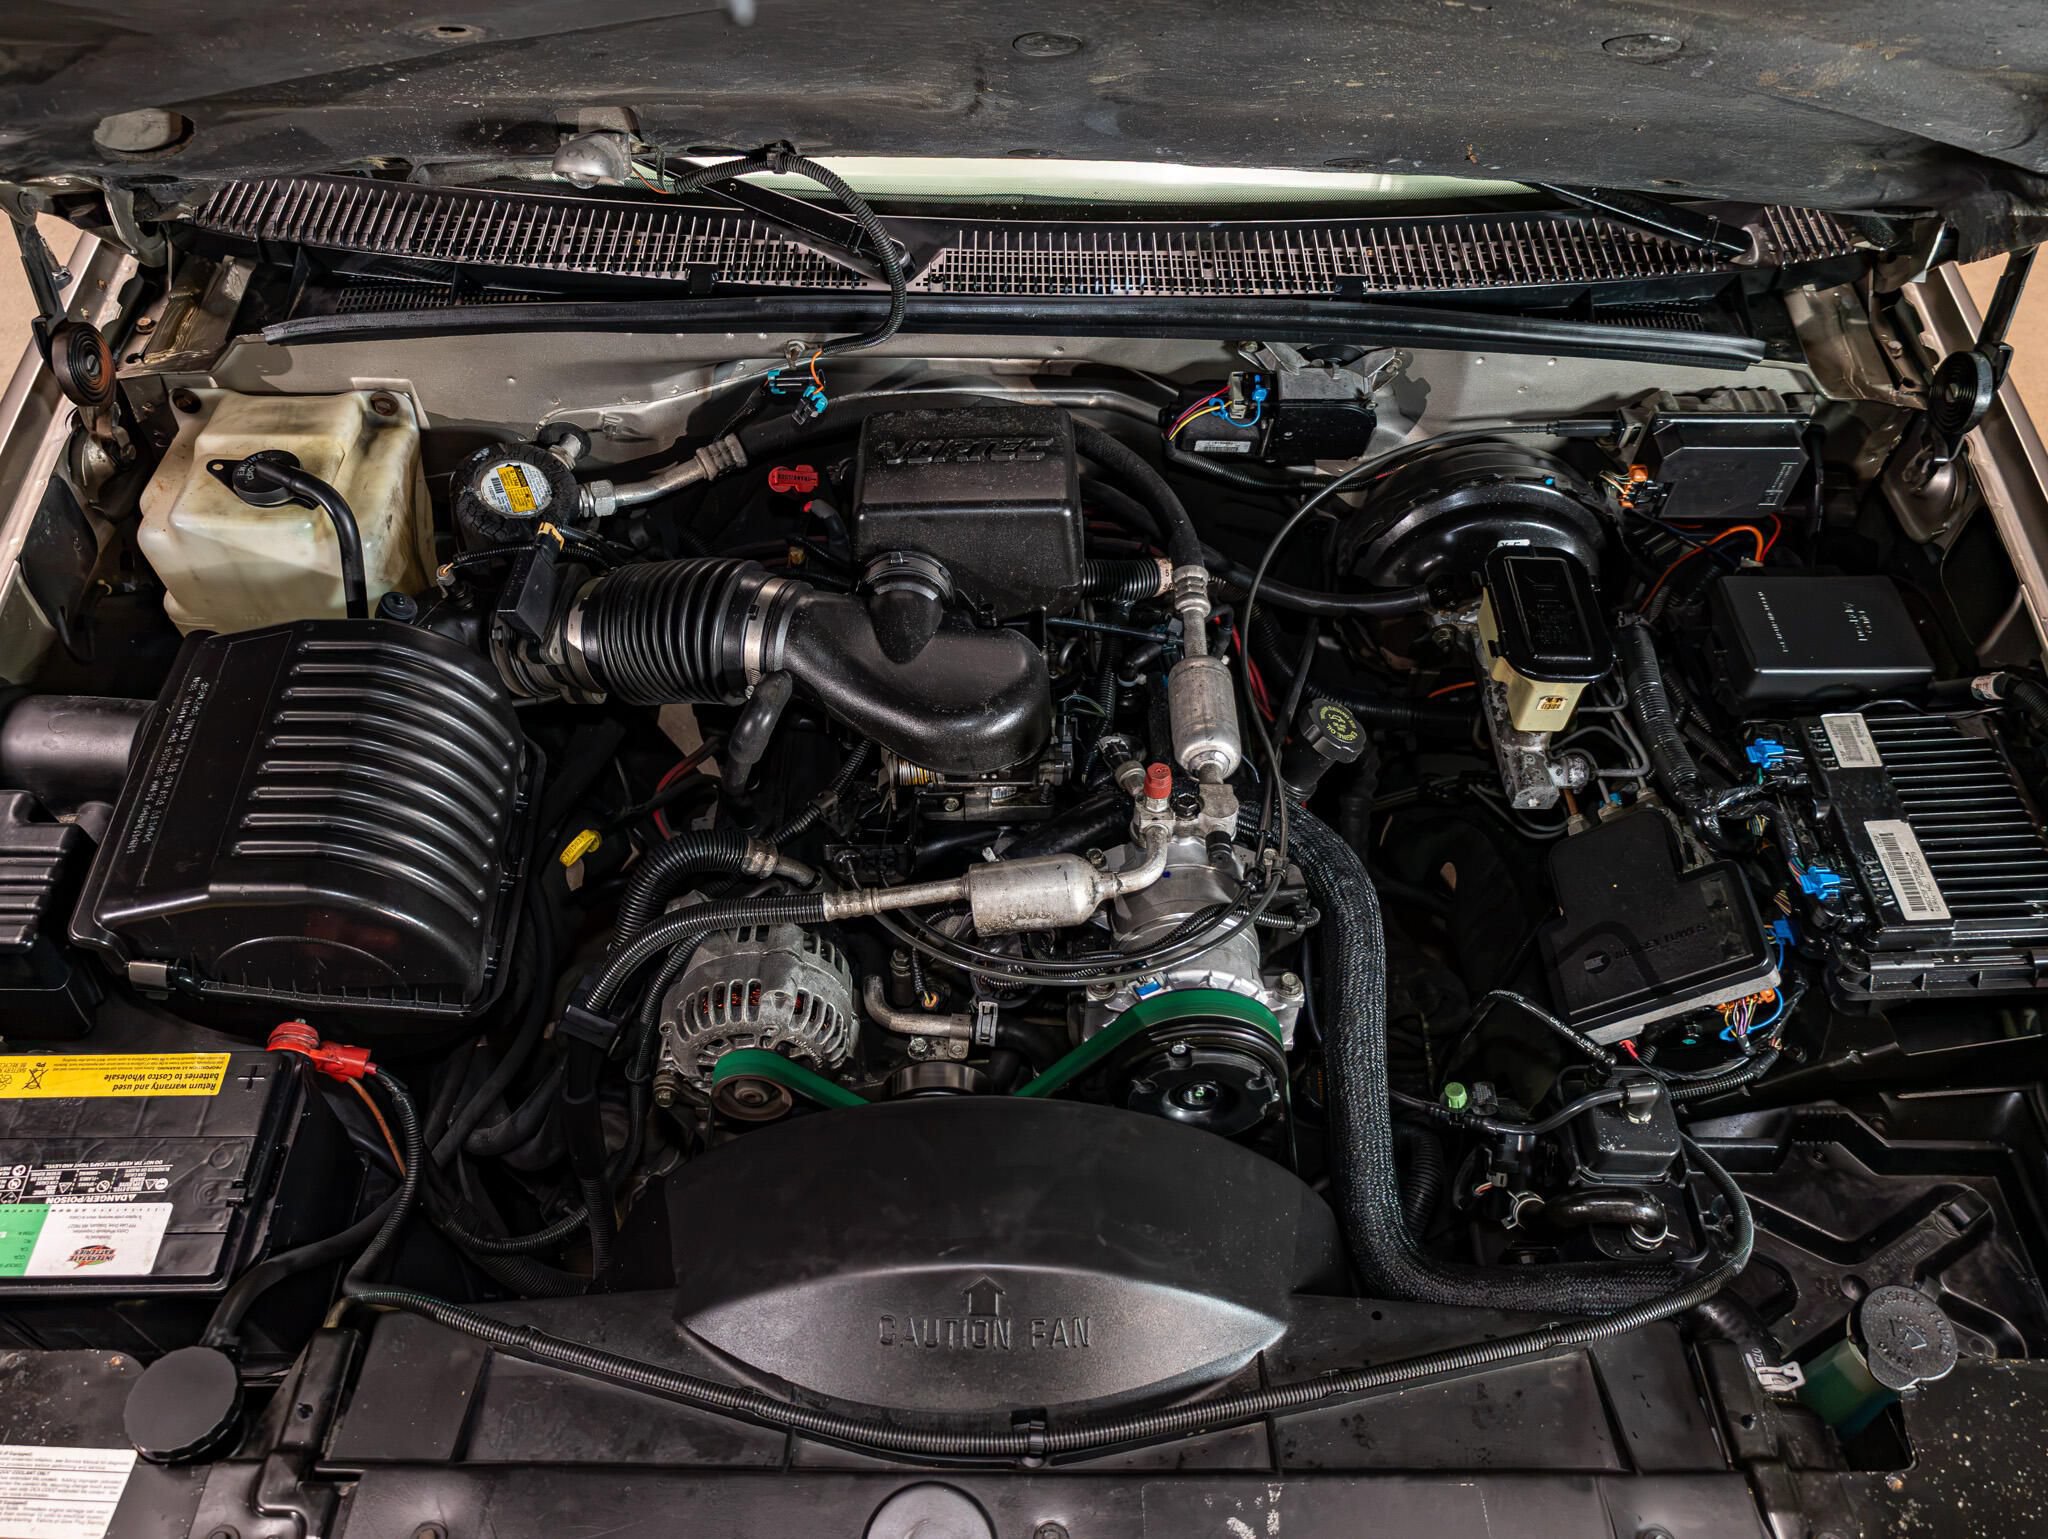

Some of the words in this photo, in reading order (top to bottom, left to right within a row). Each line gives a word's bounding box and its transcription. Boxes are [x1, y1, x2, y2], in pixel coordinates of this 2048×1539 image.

[878, 436, 1055, 465] VORTEC
[104, 1074, 145, 1082] Wholesale
[112, 1084, 132, 1092] used
[134, 1083, 150, 1091] and
[151, 1082, 187, 1090] warranty
[189, 1082, 216, 1090] Return
[45, 1194, 128, 1204] DANGER/POISON
[878, 1313, 1012, 1351] CAUTION
[1031, 1315, 1092, 1350] FAN
